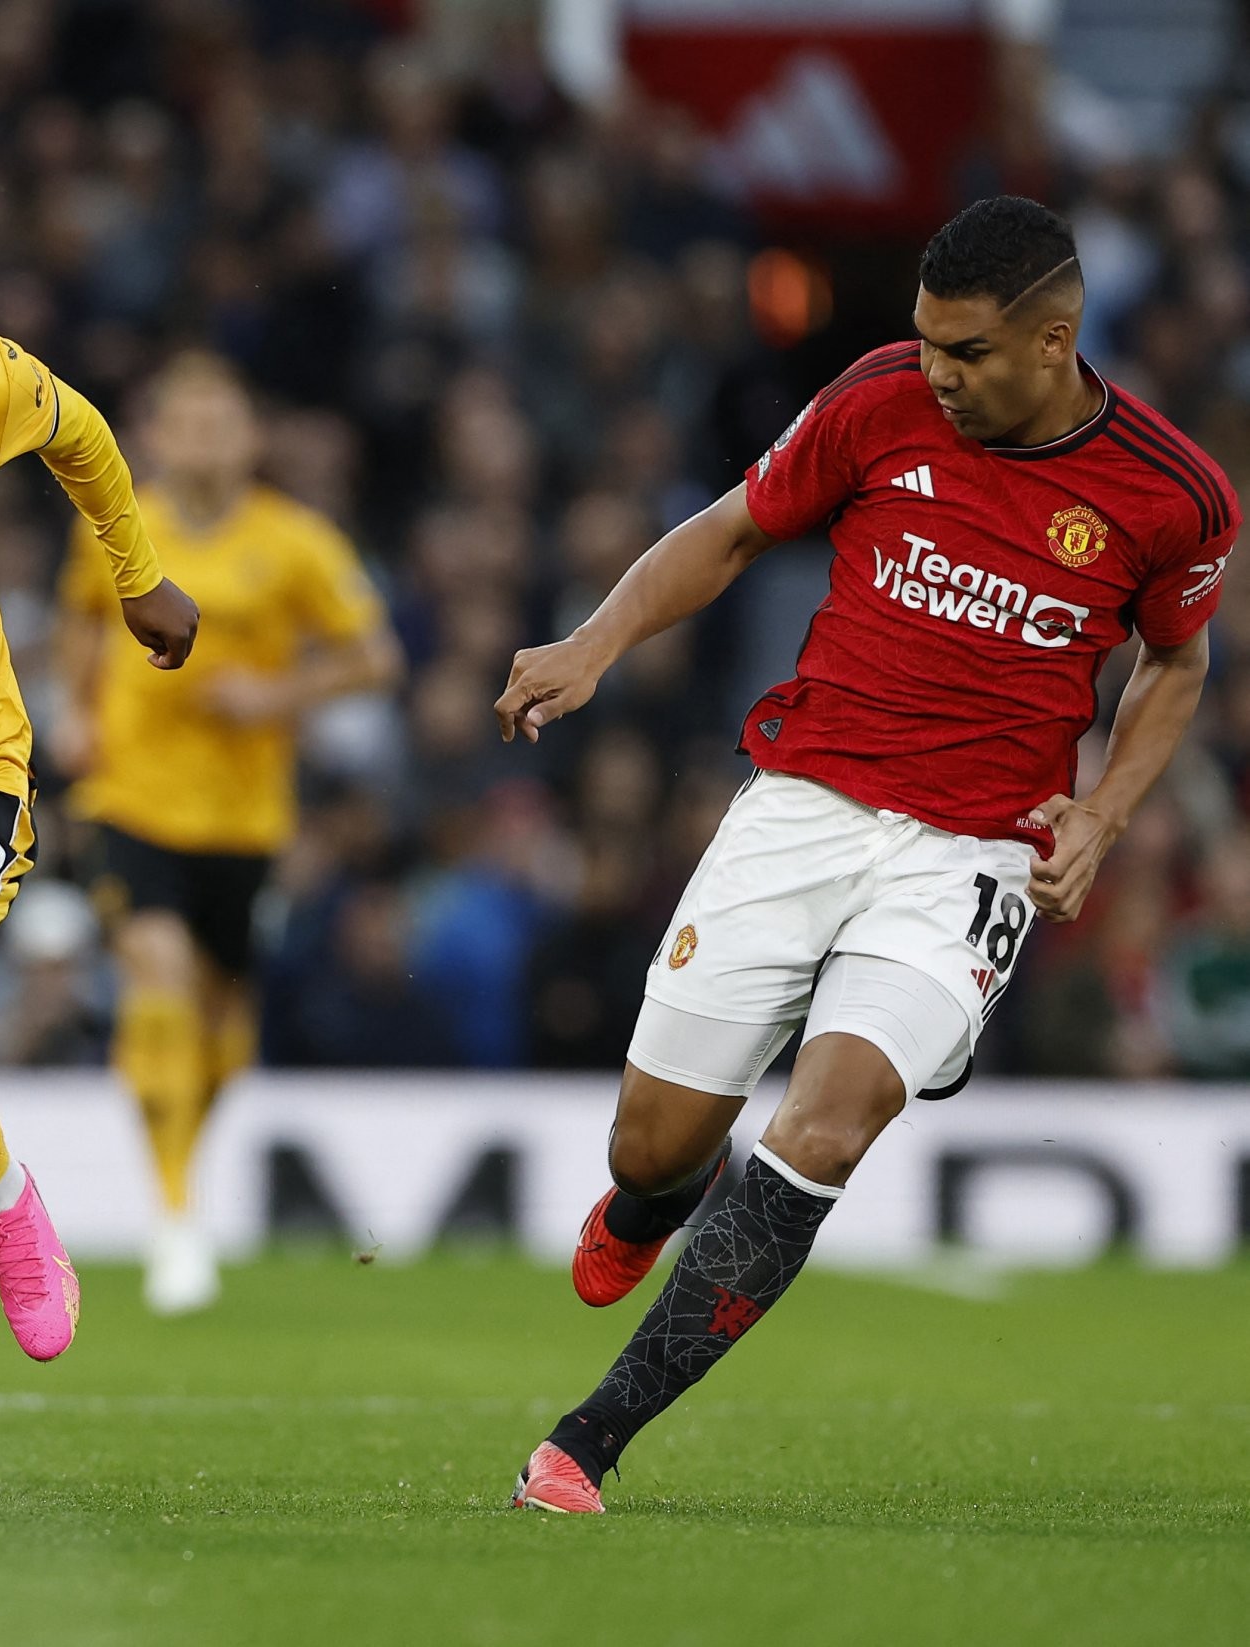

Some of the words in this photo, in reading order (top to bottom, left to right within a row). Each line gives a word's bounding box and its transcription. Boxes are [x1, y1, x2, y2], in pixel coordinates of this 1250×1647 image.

[1056, 510, 1103, 536] MANCHESTER
[1056, 549, 1089, 563] UNITED
[872, 545, 1021, 634] Viewer
[902, 531, 1028, 615] Team
[965, 872, 1026, 974] 18
